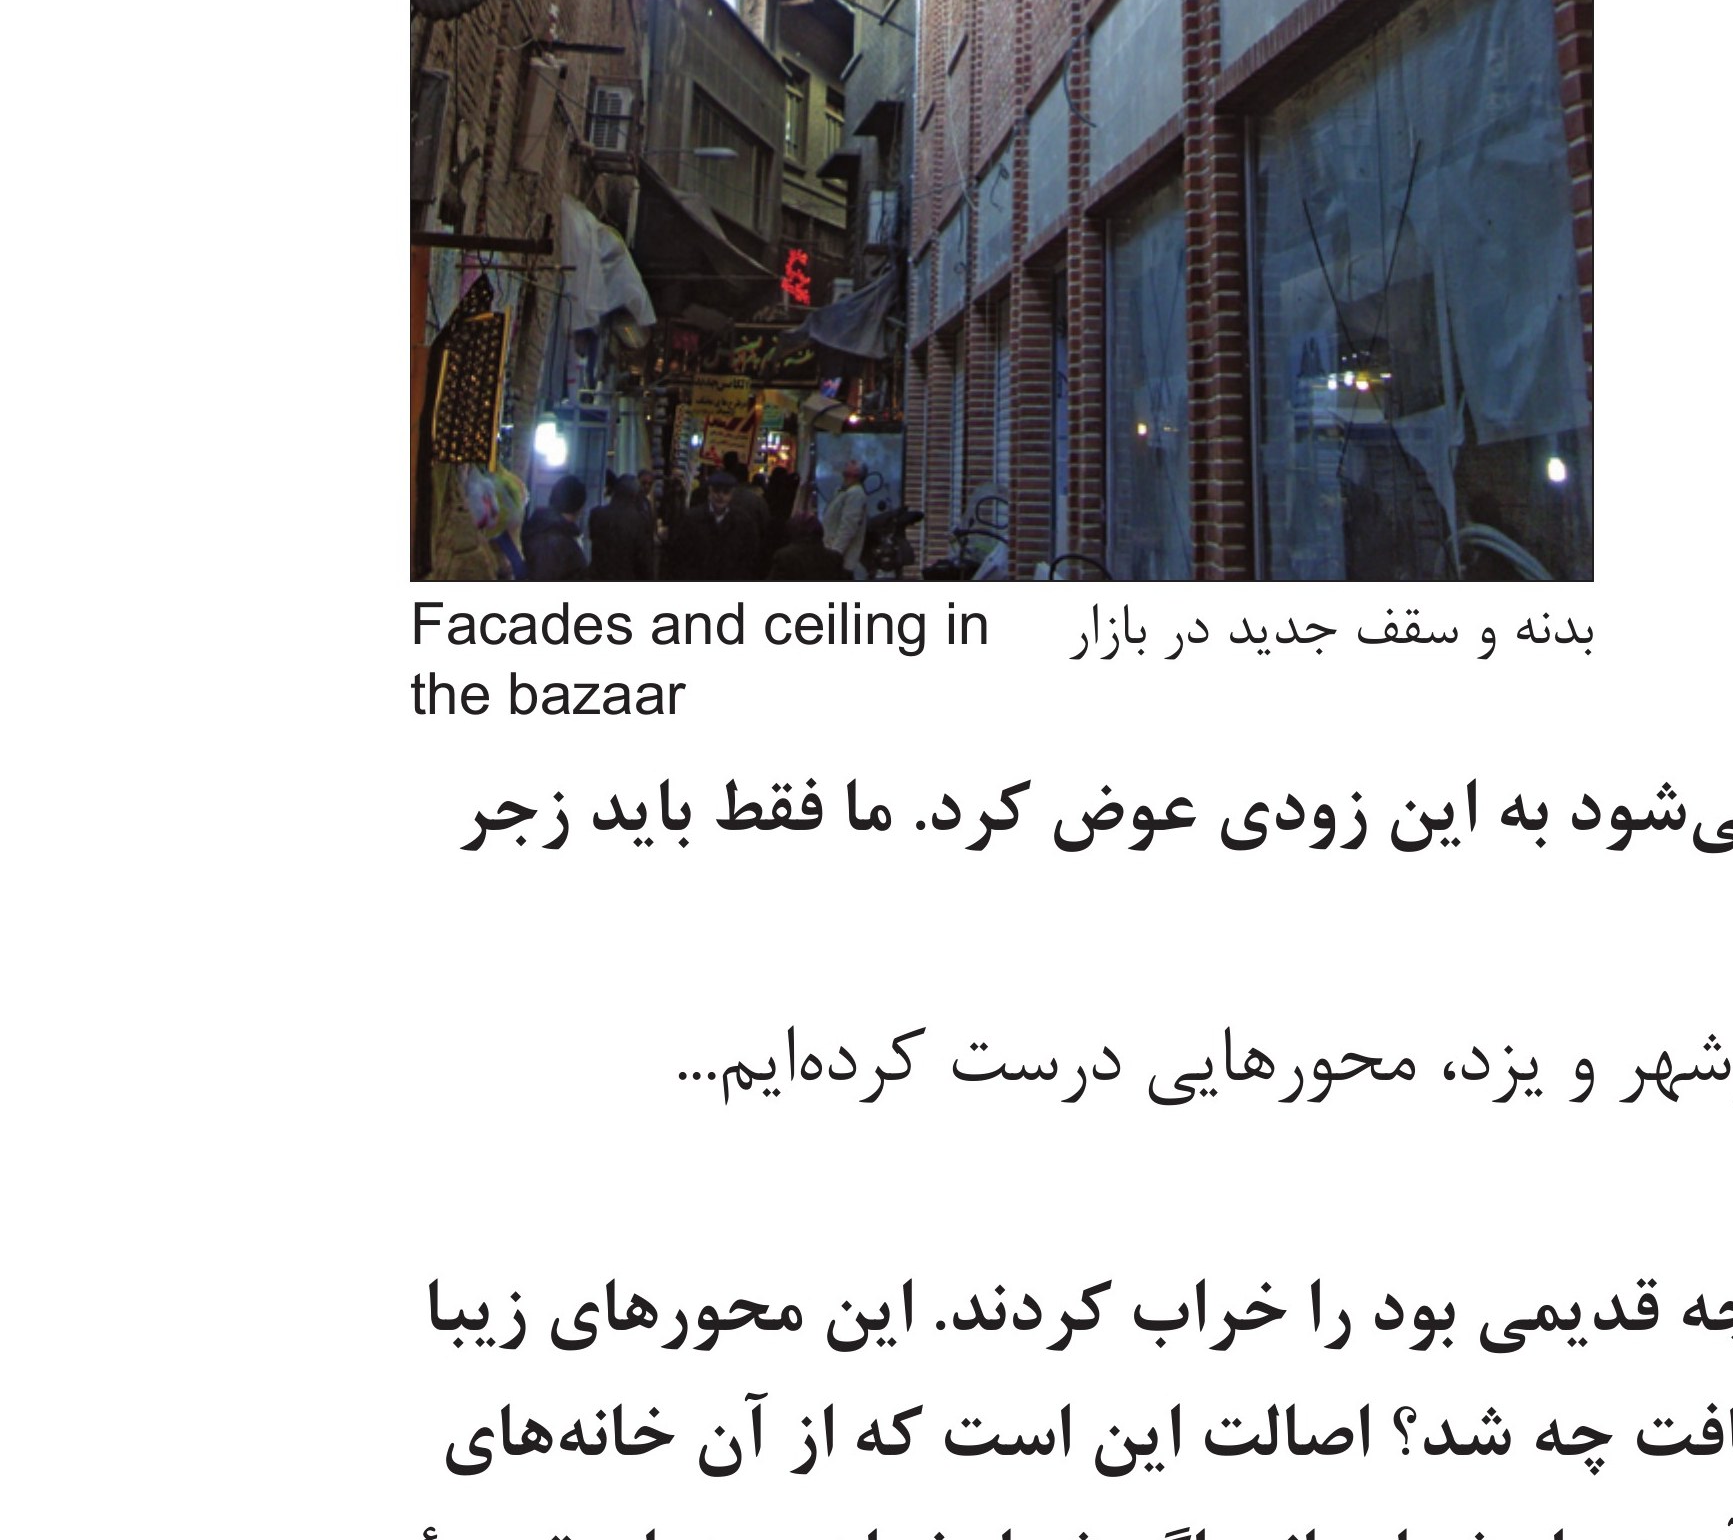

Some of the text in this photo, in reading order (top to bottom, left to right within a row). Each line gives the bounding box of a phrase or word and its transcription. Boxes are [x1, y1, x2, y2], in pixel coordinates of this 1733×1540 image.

[415, 602, 986, 656] Facades and ceiling in
[1069, 604, 1593, 659] بدنه و سقف جدید در بازار
[411, 672, 686, 715] the bazaar
[460, 791, 569, 851] زجر
[593, 779, 691, 848] باید
[716, 778, 822, 830] فقط
[847, 779, 891, 831] ما
[916, 780, 1031, 851] کرد.
[1054, 785, 1196, 852] عوض
[1221, 791, 1367, 850] زودی
[1391, 779, 1476, 852] این
[1501, 794, 1548, 848] به
[953, 1043, 1120, 1103] درست
[1149, 1027, 1415, 1105] محورهایی
[1444, 1045, 1543, 1103] یزد،
[1569, 1059, 1594, 1103] و
[429, 1279, 526, 1349] زیبا
[551, 1279, 802, 1351] محورهای
[827, 1279, 912, 1352] این
[936, 1280, 1112, 1351] کردند.
[1134, 1279, 1286, 1351] خراب
[1311, 1279, 1351, 1349] را
[1375, 1294, 1455, 1351] بود
[1480, 1278, 1658, 1353] قدیمی
[699, 1393, 768, 1477] آن
[790, 1404, 833, 1474] از
[857, 1405, 923, 1455] که
[945, 1404, 1070, 1457] است
[1095, 1404, 1180, 1477] این
[1205, 1404, 1369, 1457] اصالت
[1394, 1406, 1511, 1455] شد؟
[1536, 1419, 1612, 1475] چه
